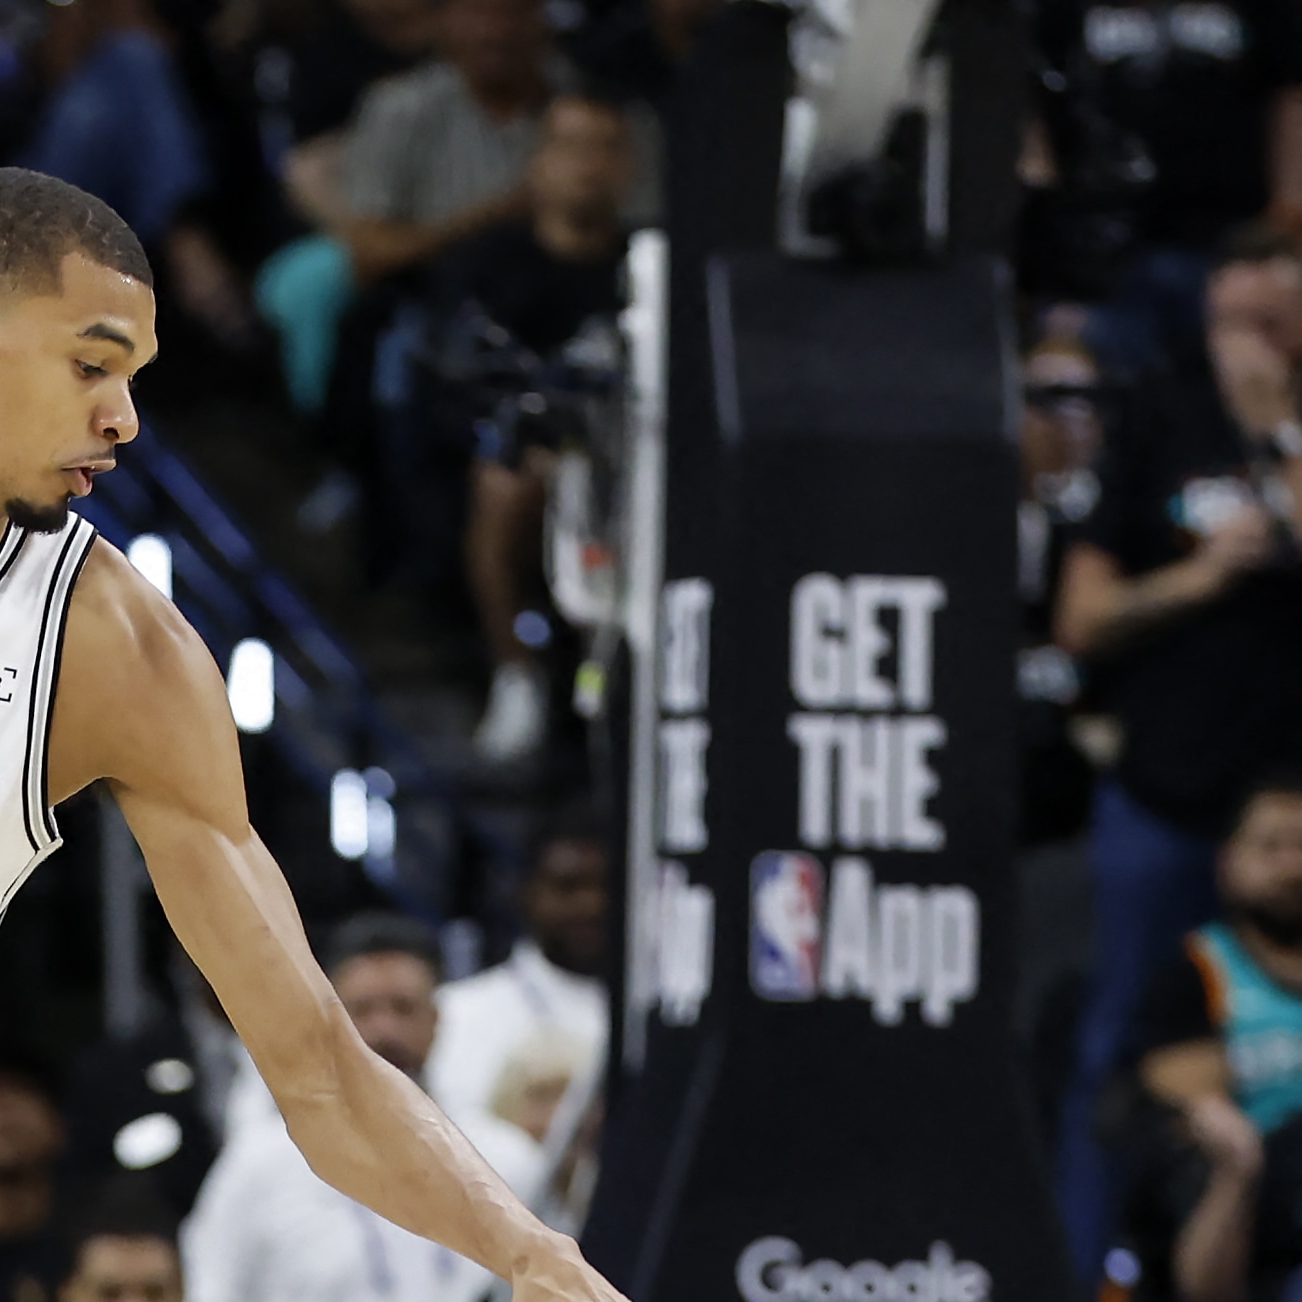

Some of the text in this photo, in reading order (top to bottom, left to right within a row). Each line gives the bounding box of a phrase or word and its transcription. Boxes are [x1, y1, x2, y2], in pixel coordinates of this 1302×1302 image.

[791, 573, 948, 710] GET
[787, 712, 948, 851] THE
[819, 857, 981, 1027] App
